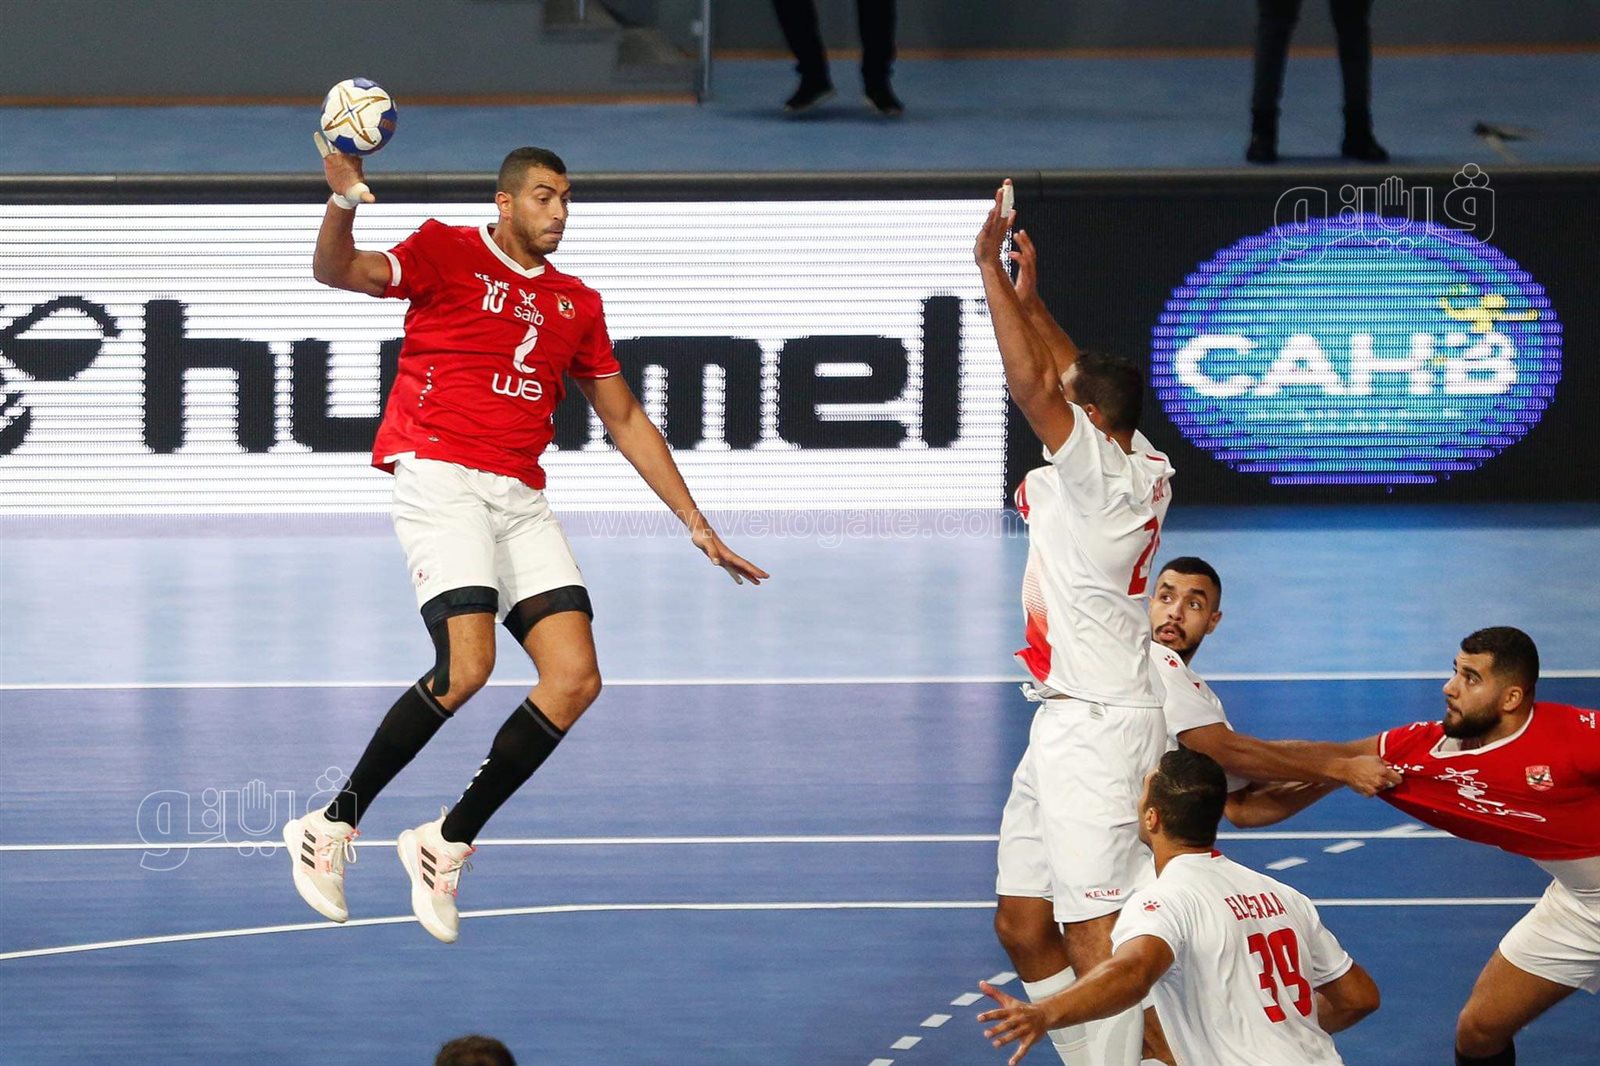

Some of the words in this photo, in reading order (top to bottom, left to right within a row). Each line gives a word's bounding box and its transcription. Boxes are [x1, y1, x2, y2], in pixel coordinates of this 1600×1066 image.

[474, 272, 510, 290] KEME
[513, 305, 545, 326] saib
[513, 324, 538, 374] 2
[1174, 333, 1517, 397] CAHB
[143, 295, 962, 453] humel
[491, 372, 543, 401] we
[1085, 888, 1121, 899] KELME
[1247, 927, 1312, 1023] 39
